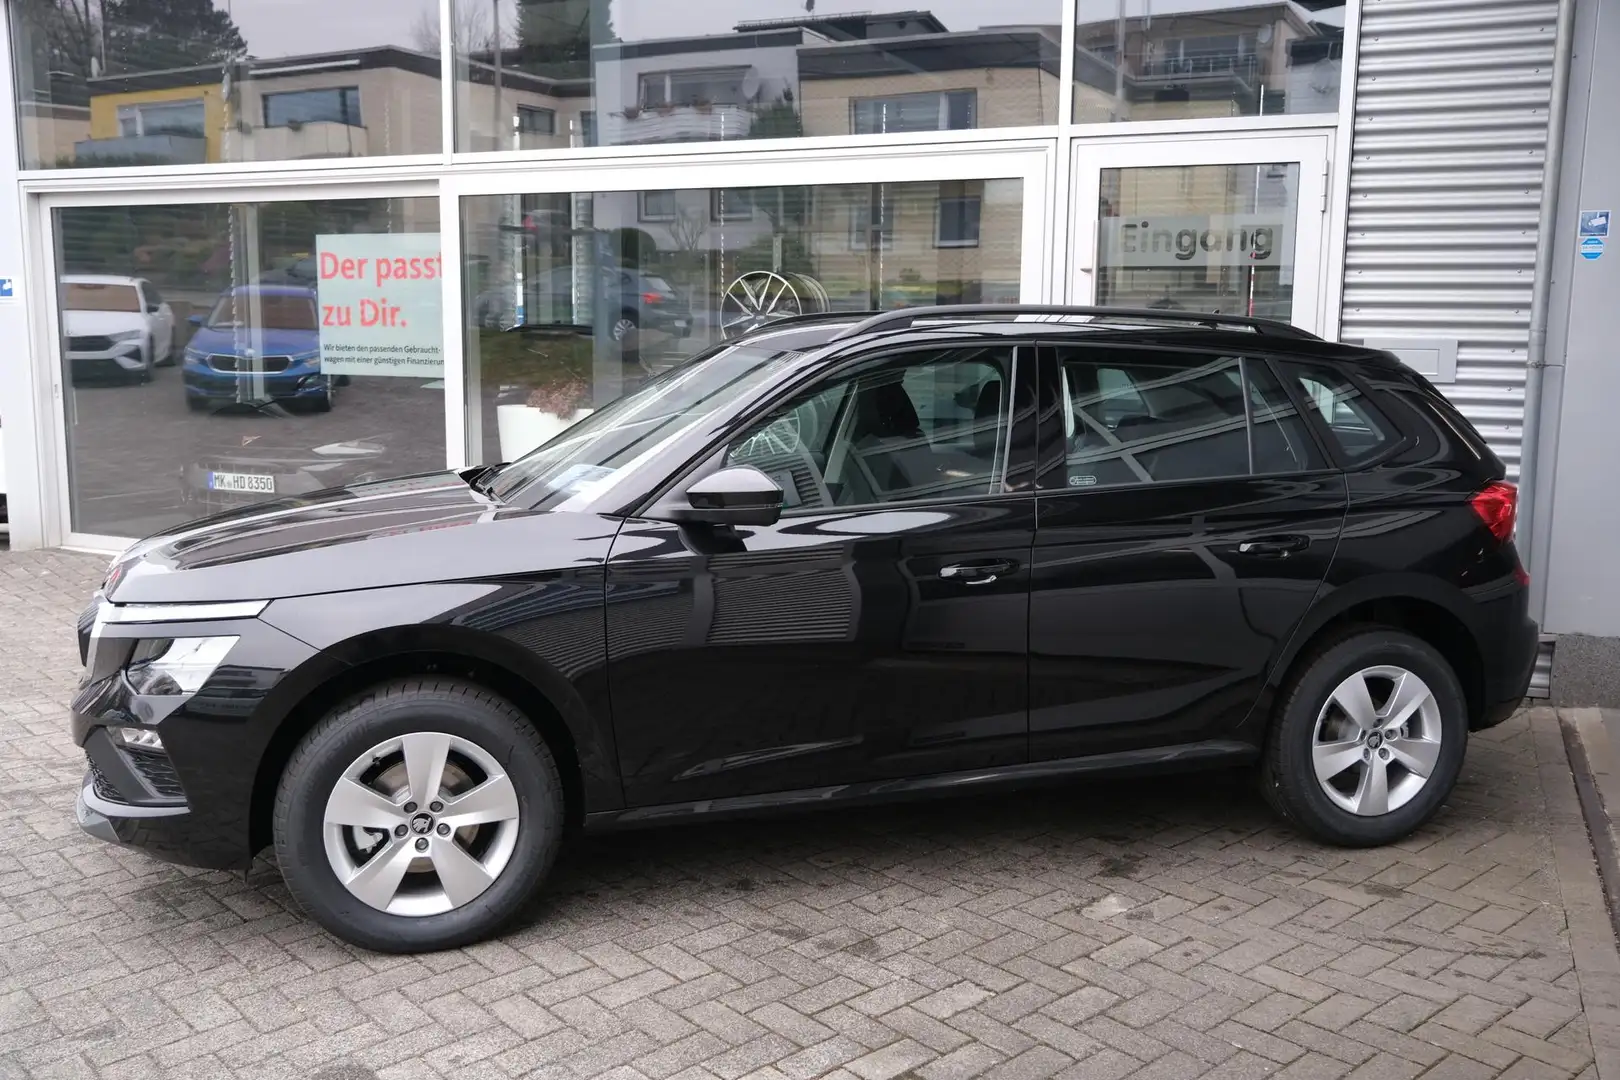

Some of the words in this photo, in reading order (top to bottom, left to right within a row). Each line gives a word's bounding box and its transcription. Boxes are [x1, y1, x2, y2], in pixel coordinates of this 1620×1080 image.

[1122, 221, 1273, 261] Eingang
[320, 251, 368, 280] Der
[322, 305, 352, 327] zu
[359, 297, 408, 328] Dir.
[323, 343, 334, 351] Wir
[335, 344, 355, 352] bieten
[369, 345, 403, 354] passenden
[404, 345, 441, 354] Gebraucht-
[324, 356, 344, 364] wagen
[374, 356, 405, 366] günstigen
[214, 474, 226, 487] MK
[233, 475, 245, 489] HD
[247, 476, 273, 490] 8350
